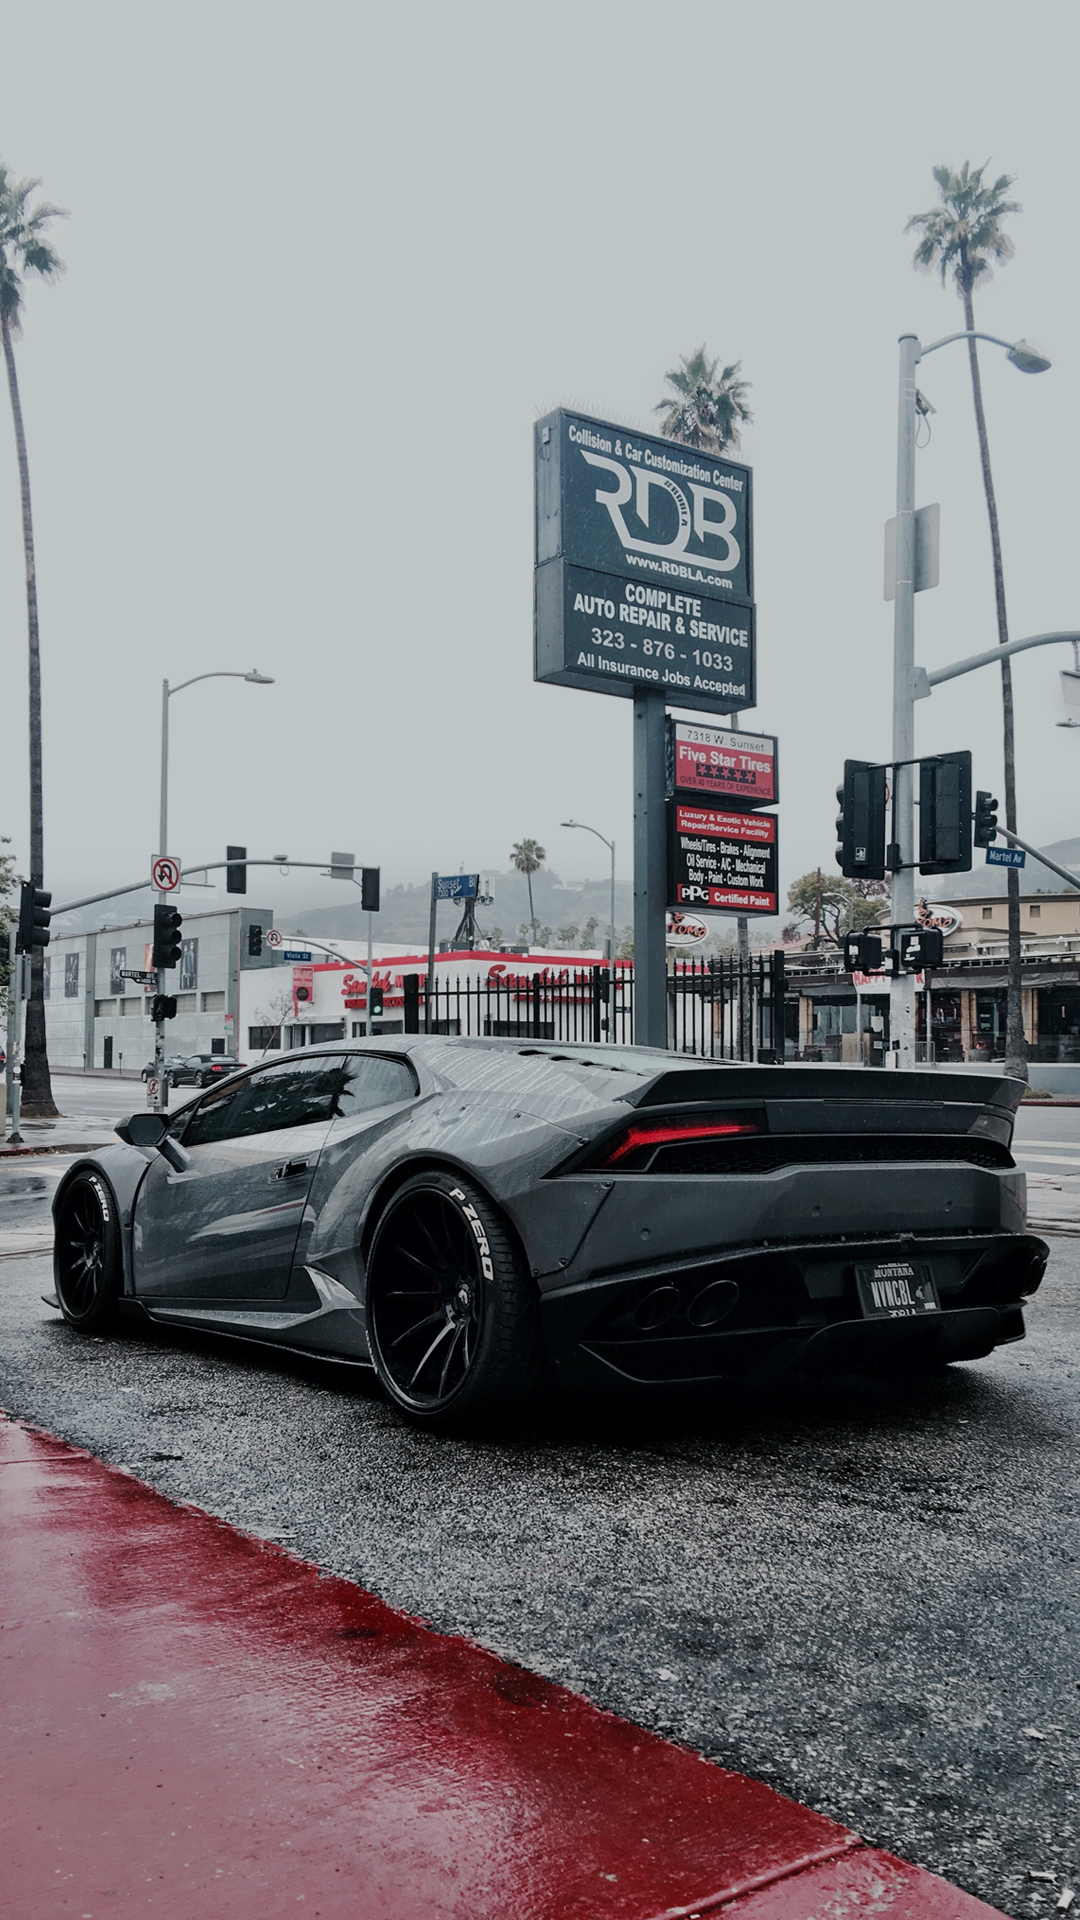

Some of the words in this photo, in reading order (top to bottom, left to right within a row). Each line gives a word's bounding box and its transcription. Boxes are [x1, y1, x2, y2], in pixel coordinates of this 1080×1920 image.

[569, 425, 612, 454] Collision
[614, 439, 623, 457] &
[625, 442, 643, 463] Car
[644, 449, 711, 484] Customization
[713, 470, 744, 492] Center
[579, 449, 741, 573] RDB
[626, 554, 733, 590] www.RDBLA.com
[625, 583, 702, 618] COMPLETE
[573, 593, 616, 620] AUTO
[619, 603, 672, 633] REPAIR
[675, 616, 686, 635] &
[690, 619, 749, 648] SERVICE
[591, 627, 625, 650] 323
[643, 639, 675, 660] 876
[692, 649, 734, 672] 1033
[577, 652, 595, 668] All
[598, 656, 659, 680] Insurance
[662, 669, 691, 687] Jobs
[694, 675, 746, 697] Accepted
[687, 730, 711, 743] 7318
[730, 737, 765, 752] Sunset
[679, 745, 707, 763] Five
[710, 751, 736, 768] Star
[739, 756, 771, 774] Tires
[680, 775, 697, 785] OVER
[706, 778, 726, 790] YEARS
[727, 782, 735, 790] OF
[736, 783, 771, 796] EXPERIENCE
[679, 810, 707, 822] Luxury
[709, 814, 716, 822] &
[717, 815, 742, 826] Exotic
[743, 818, 771, 829] Vehicle
[681, 819, 739, 834] Repair/Service
[741, 827, 769, 838] Facility
[680, 836, 716, 854] Wheels/Tires
[720, 841, 740, 856] Brakes
[743, 844, 771, 860] Alignment
[989, 850, 1012, 863] Martel
[1012, 853, 1022, 863] Av
[686, 853, 695, 868] Oil
[696, 854, 717, 870] Service
[735, 859, 766, 875] Mechanical
[437, 877, 460, 890] Sunset
[688, 868, 704, 884] Body
[708, 870, 723, 884] Paint
[727, 872, 749, 887] Custom
[749, 875, 764, 888] Work
[681, 885, 709, 901] PPG
[714, 892, 748, 905] Certified
[749, 895, 770, 907] Paint
[286, 951, 300, 960] Vista
[302, 952, 309, 960] St
[121, 970, 141, 979] MARTEL
[94, 1182, 110, 1222] ZERO
[449, 1187, 466, 1201] P
[461, 1203, 494, 1281] ZERO
[873, 1266, 915, 1278] MONTANA
